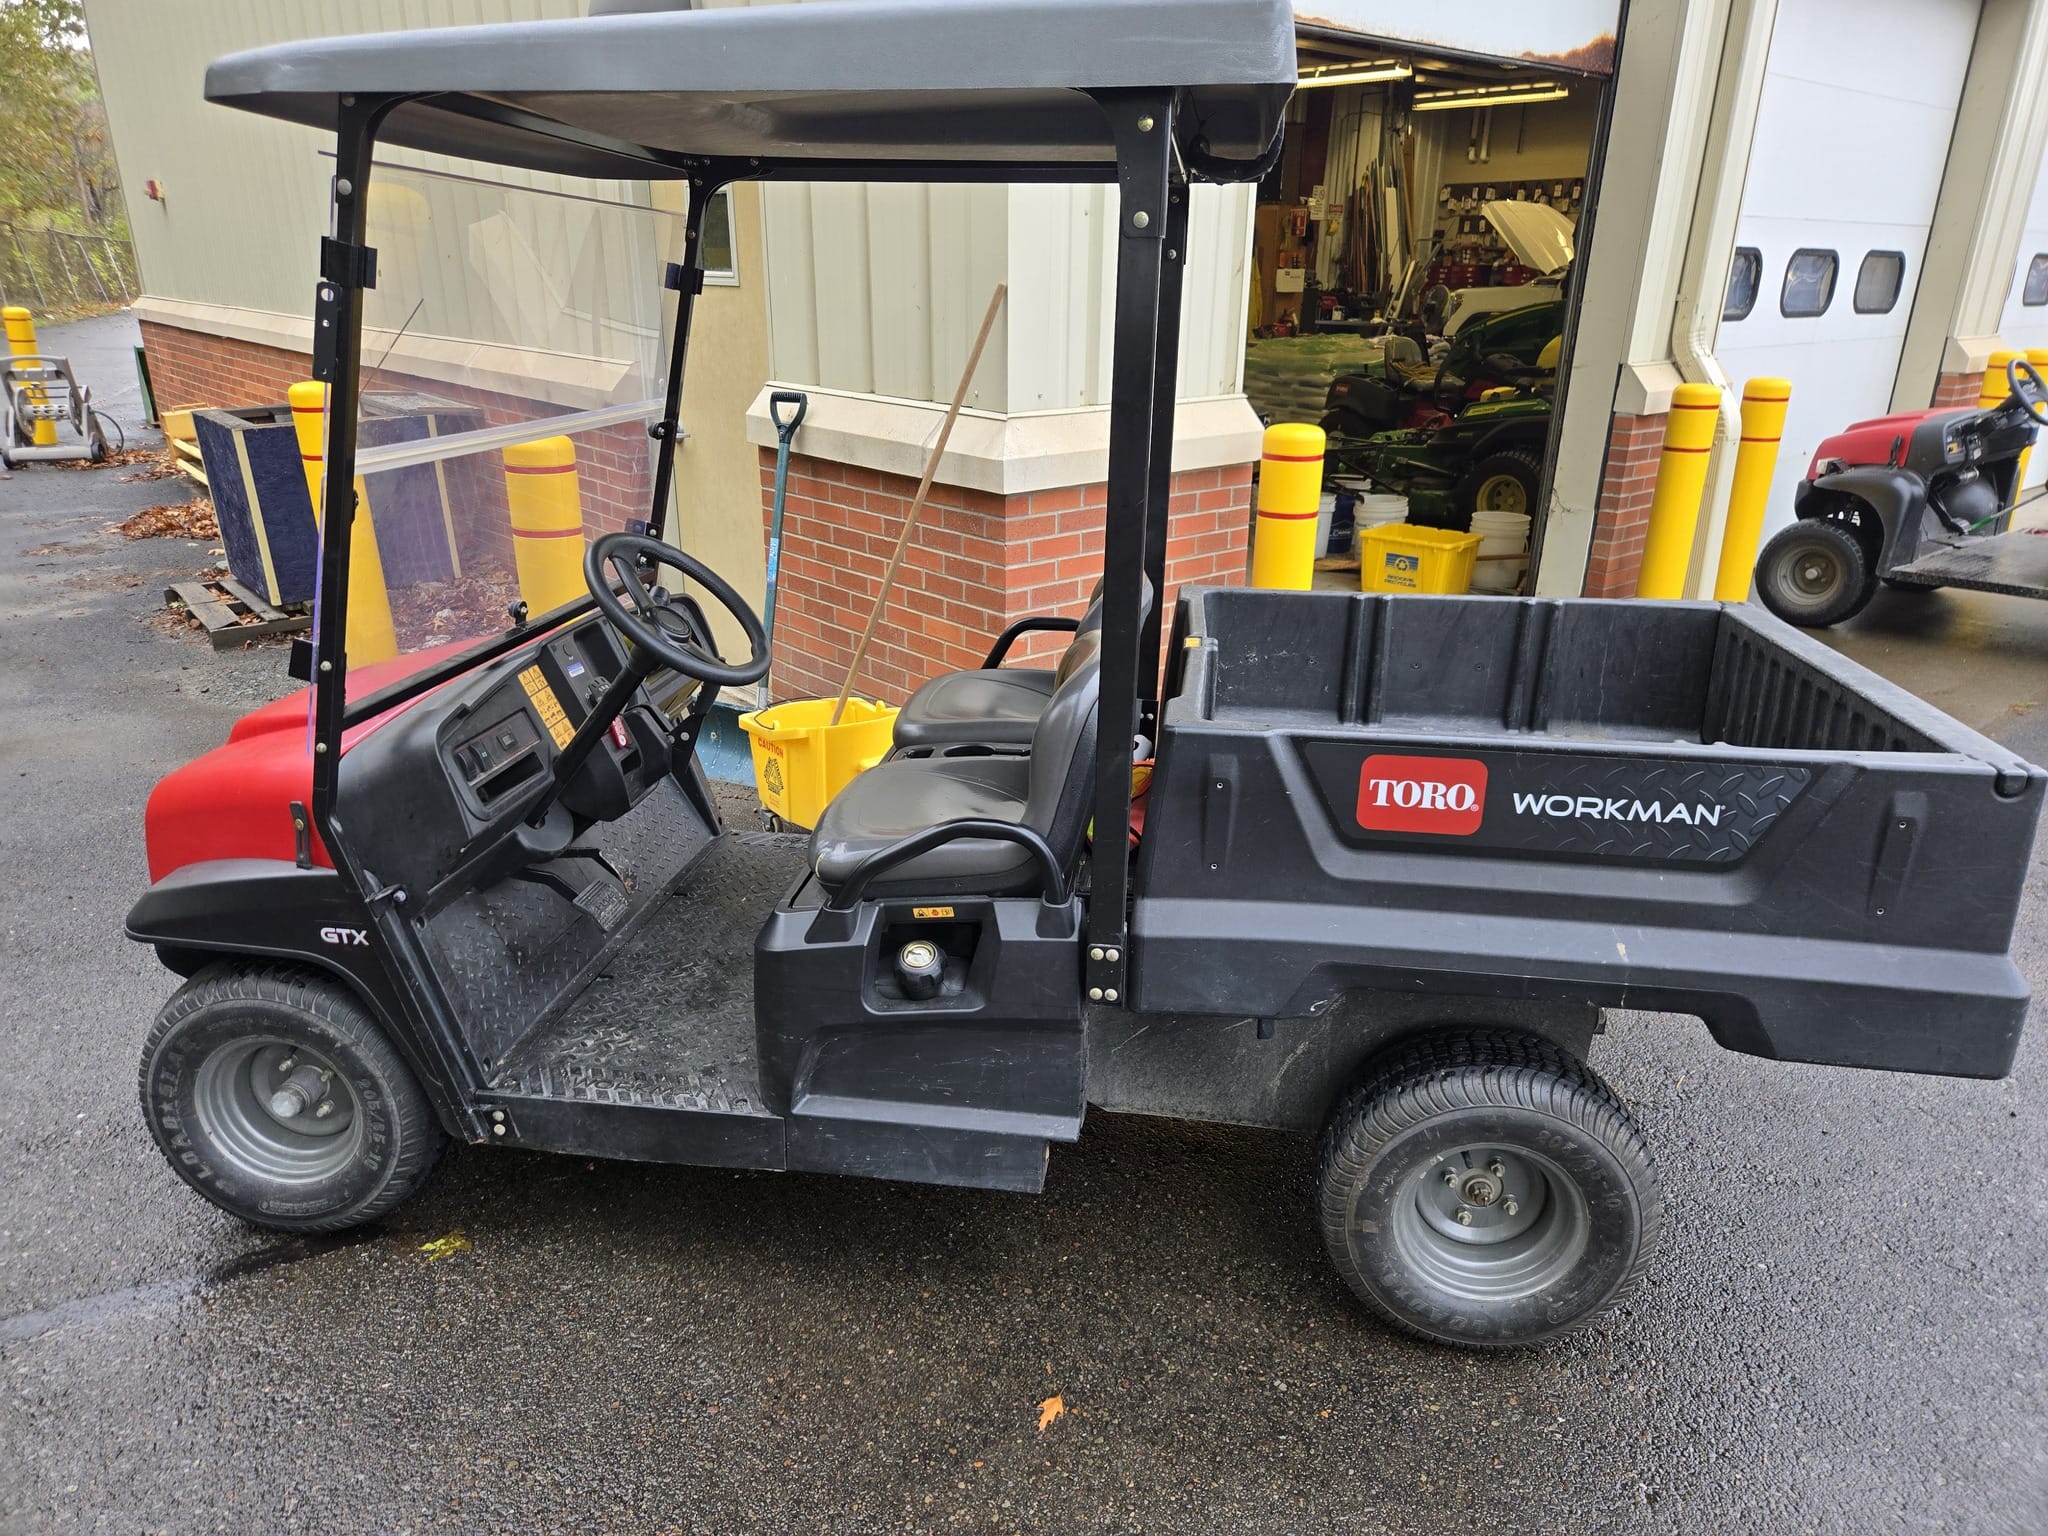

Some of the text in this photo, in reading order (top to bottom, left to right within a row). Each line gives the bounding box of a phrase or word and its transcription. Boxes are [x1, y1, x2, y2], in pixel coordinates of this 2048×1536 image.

[757, 736, 784, 758] CAUTION
[1369, 778, 1476, 811] TORO
[1513, 792, 1721, 827] WORKMAN
[320, 927, 369, 946] GTX
